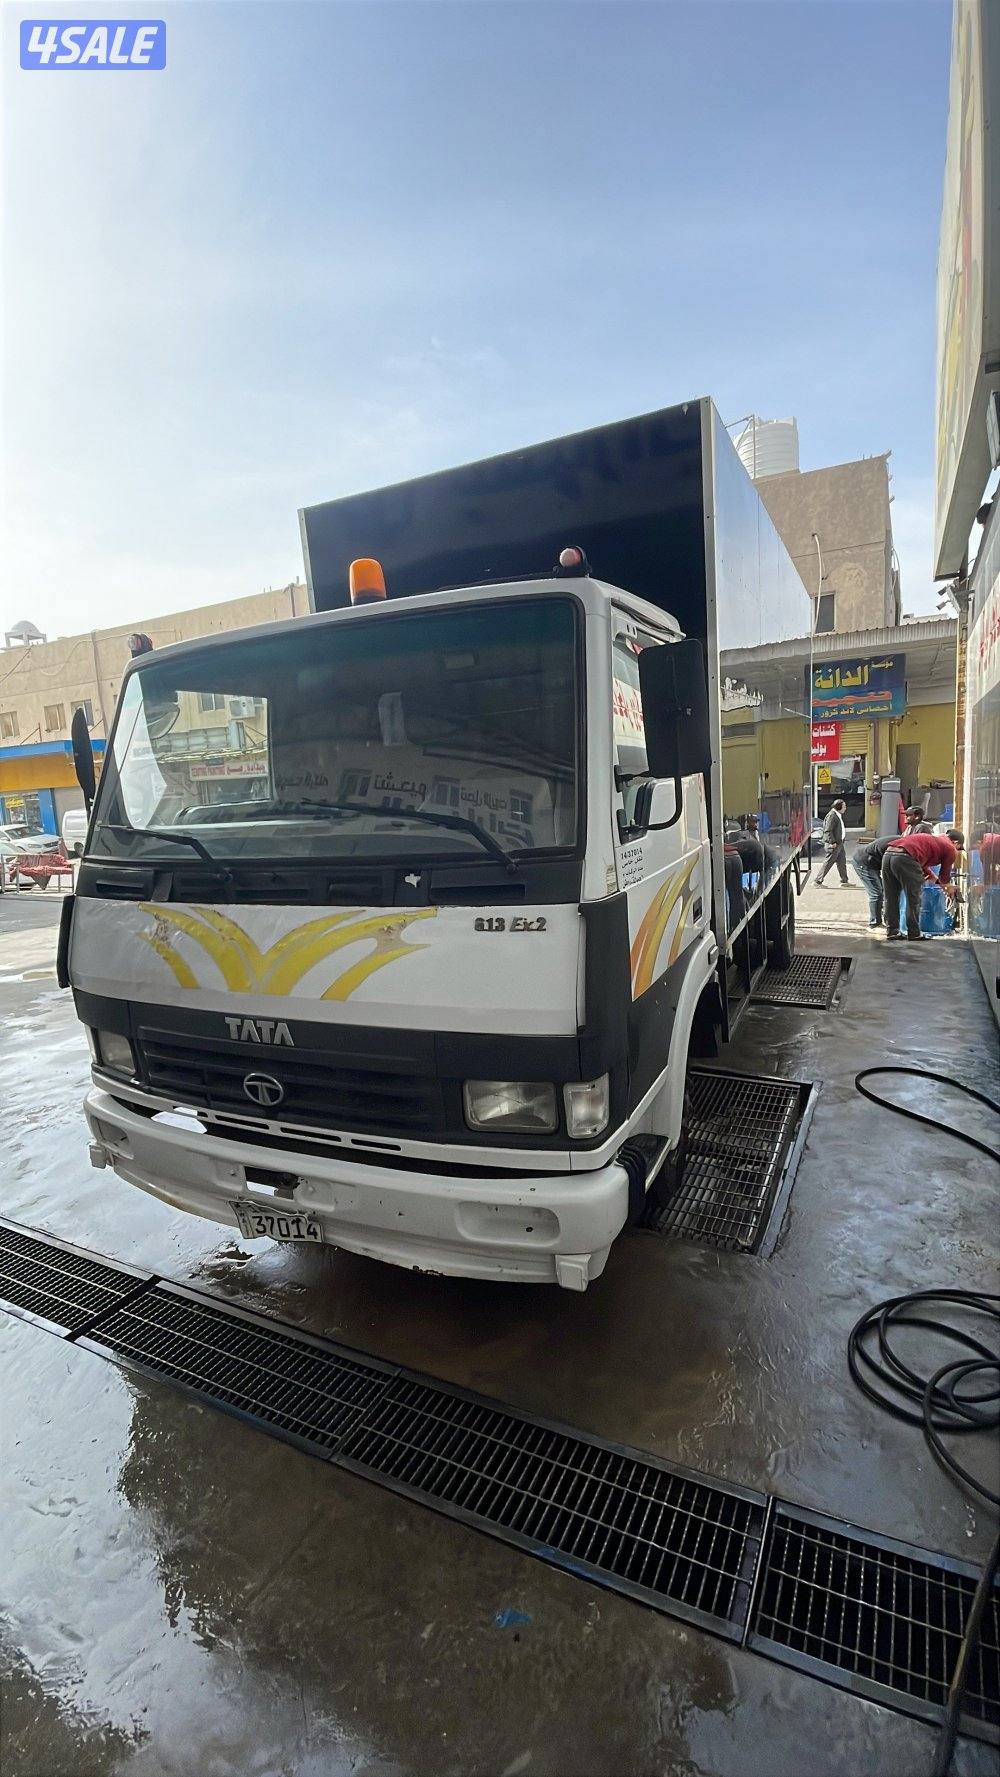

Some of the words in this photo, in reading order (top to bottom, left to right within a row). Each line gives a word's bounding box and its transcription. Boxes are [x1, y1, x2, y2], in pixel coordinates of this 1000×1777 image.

[814, 665, 869, 689] الدانة
[474, 917, 506, 932] 613
[224, 1016, 295, 1047] TATA
[251, 1215, 318, 1240] 37014
